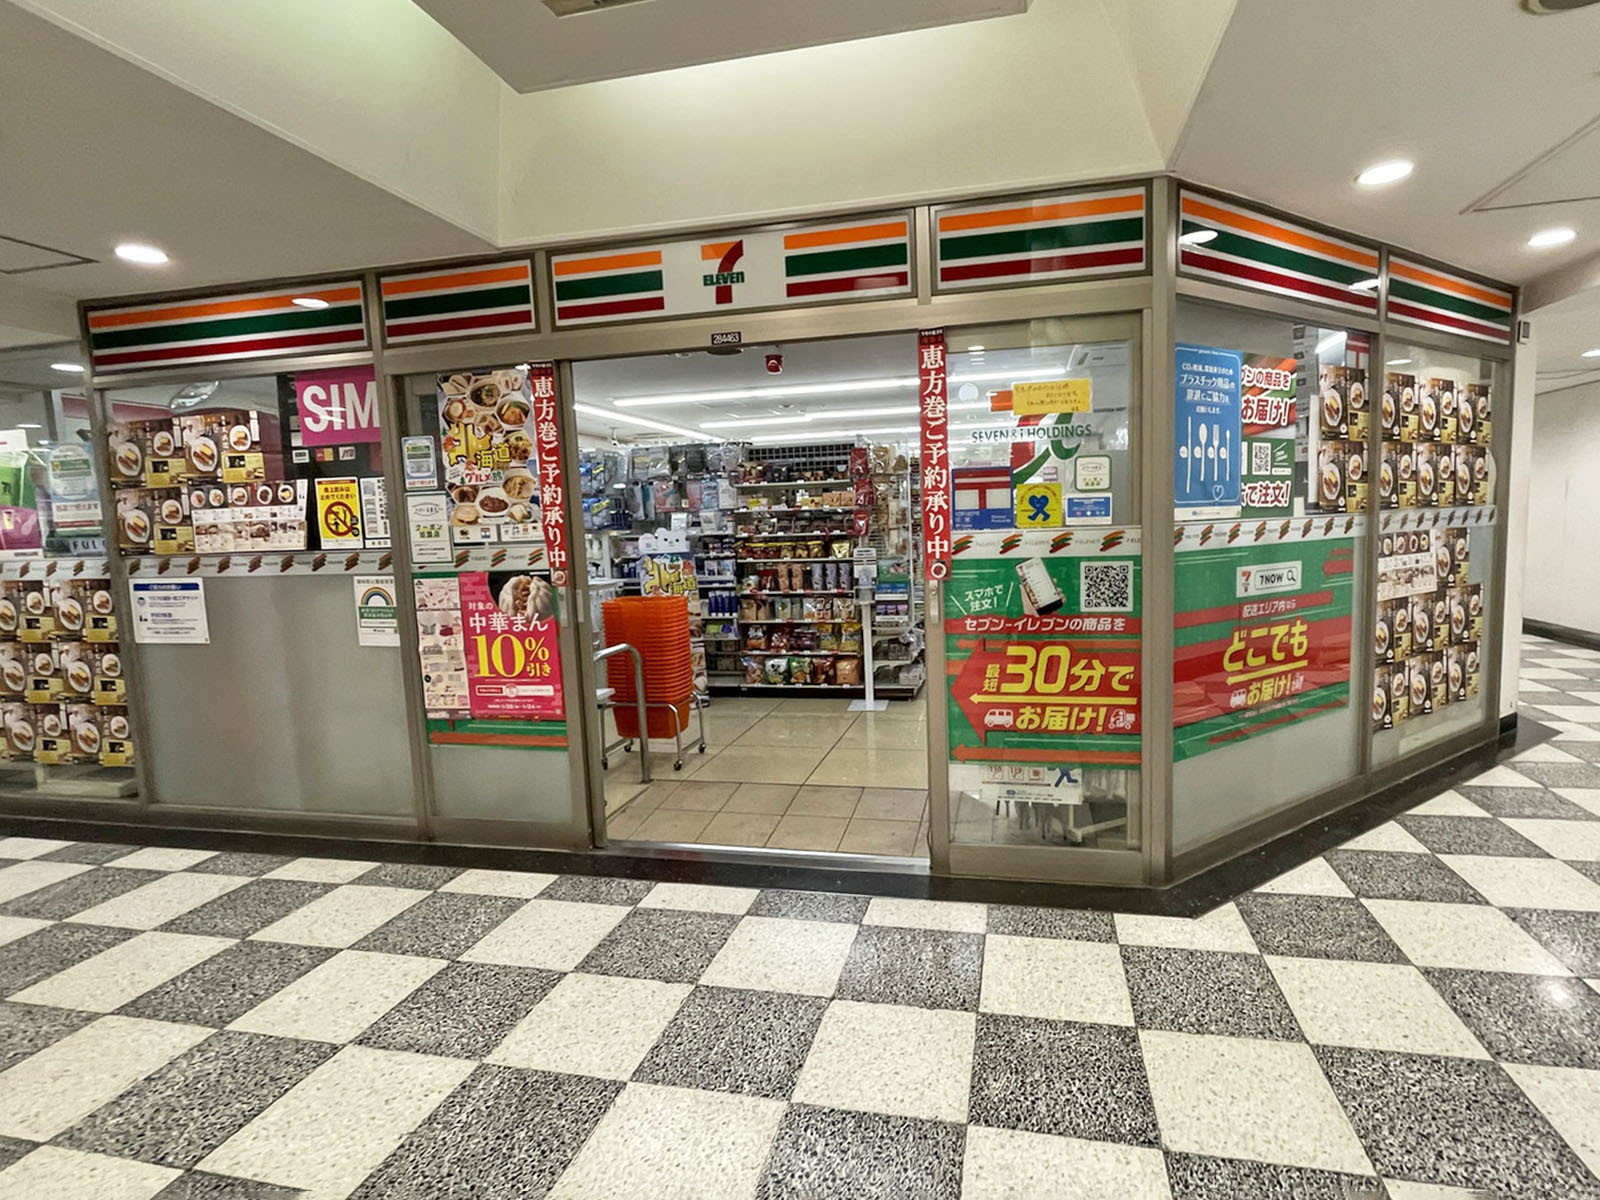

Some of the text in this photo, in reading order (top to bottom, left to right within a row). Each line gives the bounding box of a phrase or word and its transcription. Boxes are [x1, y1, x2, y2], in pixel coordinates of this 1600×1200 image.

[302, 381, 380, 433] SIM
[972, 429, 1009, 444] SEVEN
[1027, 424, 1092, 440] HOLDINGS
[1259, 572, 1285, 585] 7NOW
[964, 583, 1004, 602] スマホで
[970, 600, 998, 613] 注文!
[469, 612, 549, 634] 中華まん
[1223, 620, 1308, 673] どこでも
[982, 645, 1135, 694] 最短 30分で
[1016, 706, 1108, 732] お届け!
